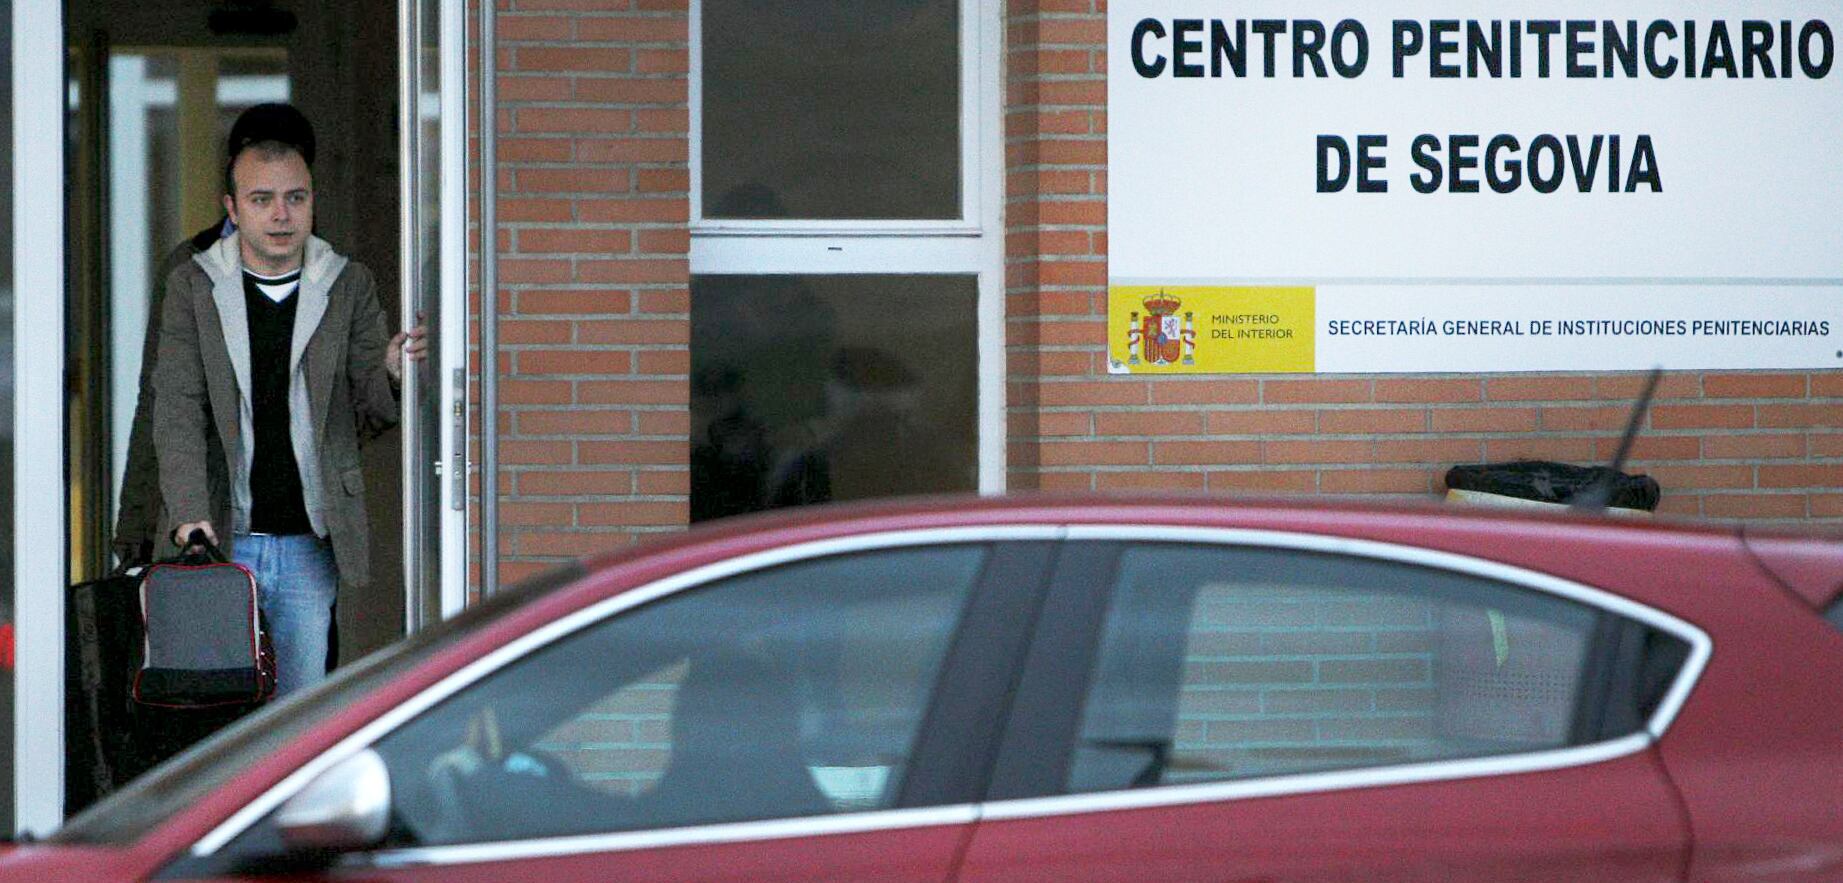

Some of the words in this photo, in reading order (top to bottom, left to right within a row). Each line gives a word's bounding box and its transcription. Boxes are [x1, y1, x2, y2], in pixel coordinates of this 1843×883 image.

[1130, 17, 1369, 79] CENTRO
[1392, 18, 1835, 80] PENITENCIARIO
[1316, 134, 1388, 193] DE
[1409, 133, 1663, 194] SEGOVIA
[1211, 314, 1280, 325] MINISTERIO
[1328, 317, 1438, 336] SECRETARÍA
[1442, 320, 1524, 336] GENERAL
[1530, 320, 1552, 336] DE
[1558, 320, 1687, 336] INSTITUCIONES
[1692, 320, 1830, 337] PENITENCIARIAS
[1211, 329, 1234, 339] DEL
[1237, 328, 1293, 339] INTERIOR
